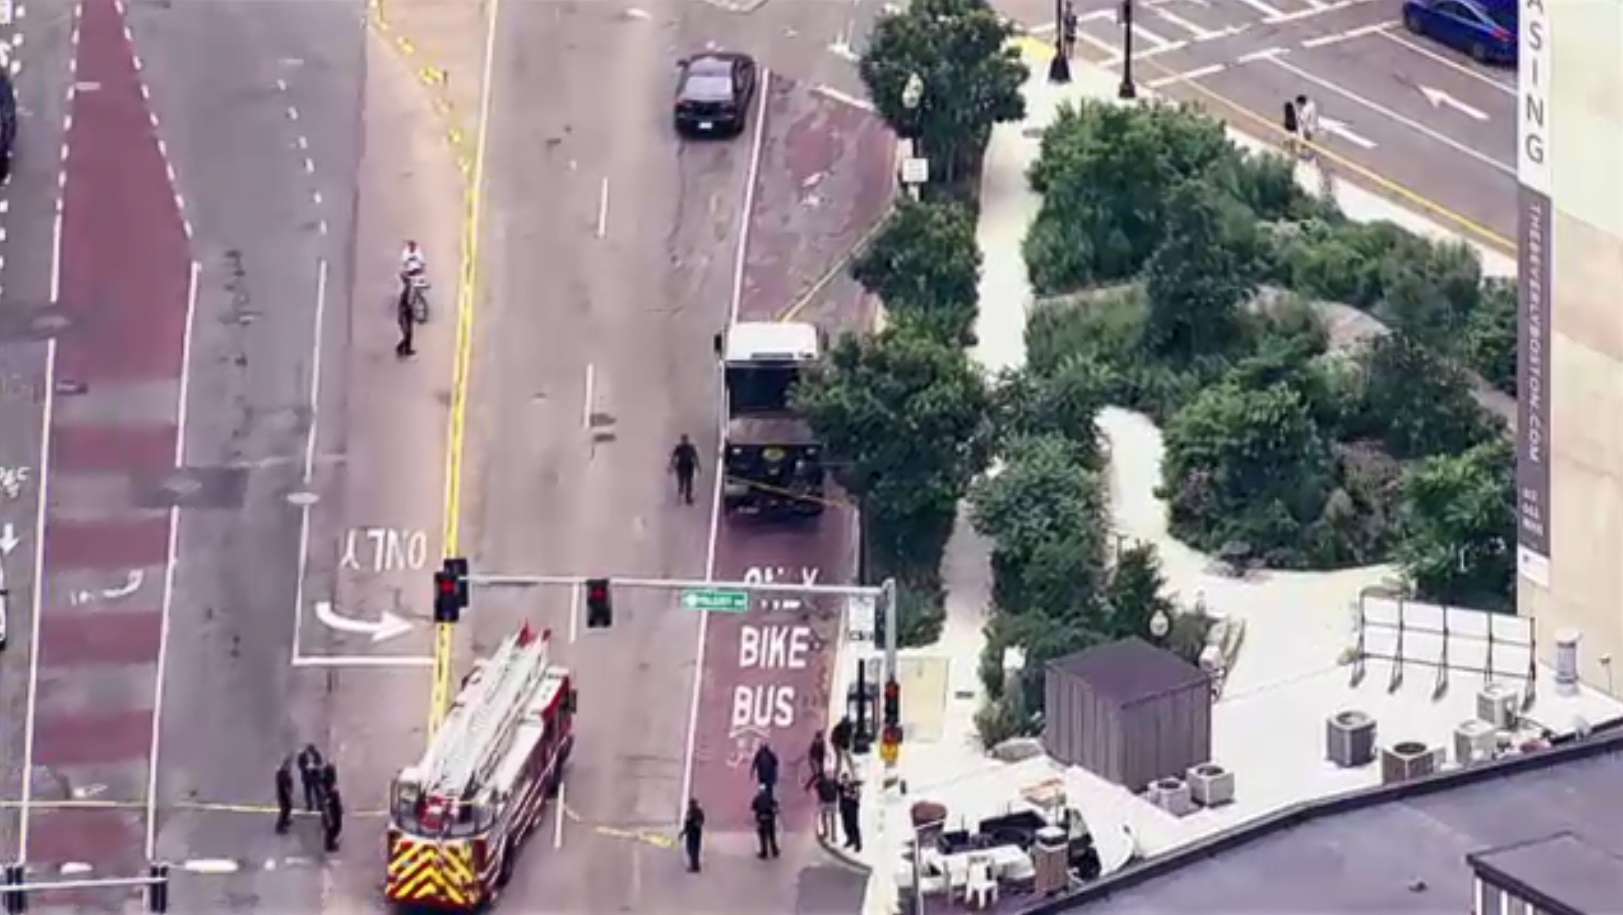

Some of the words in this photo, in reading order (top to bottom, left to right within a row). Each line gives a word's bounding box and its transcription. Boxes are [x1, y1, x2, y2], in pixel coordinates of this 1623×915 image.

[340, 528, 427, 572] ONLY
[738, 625, 811, 669] BIKE
[731, 684, 796, 727] BUS
